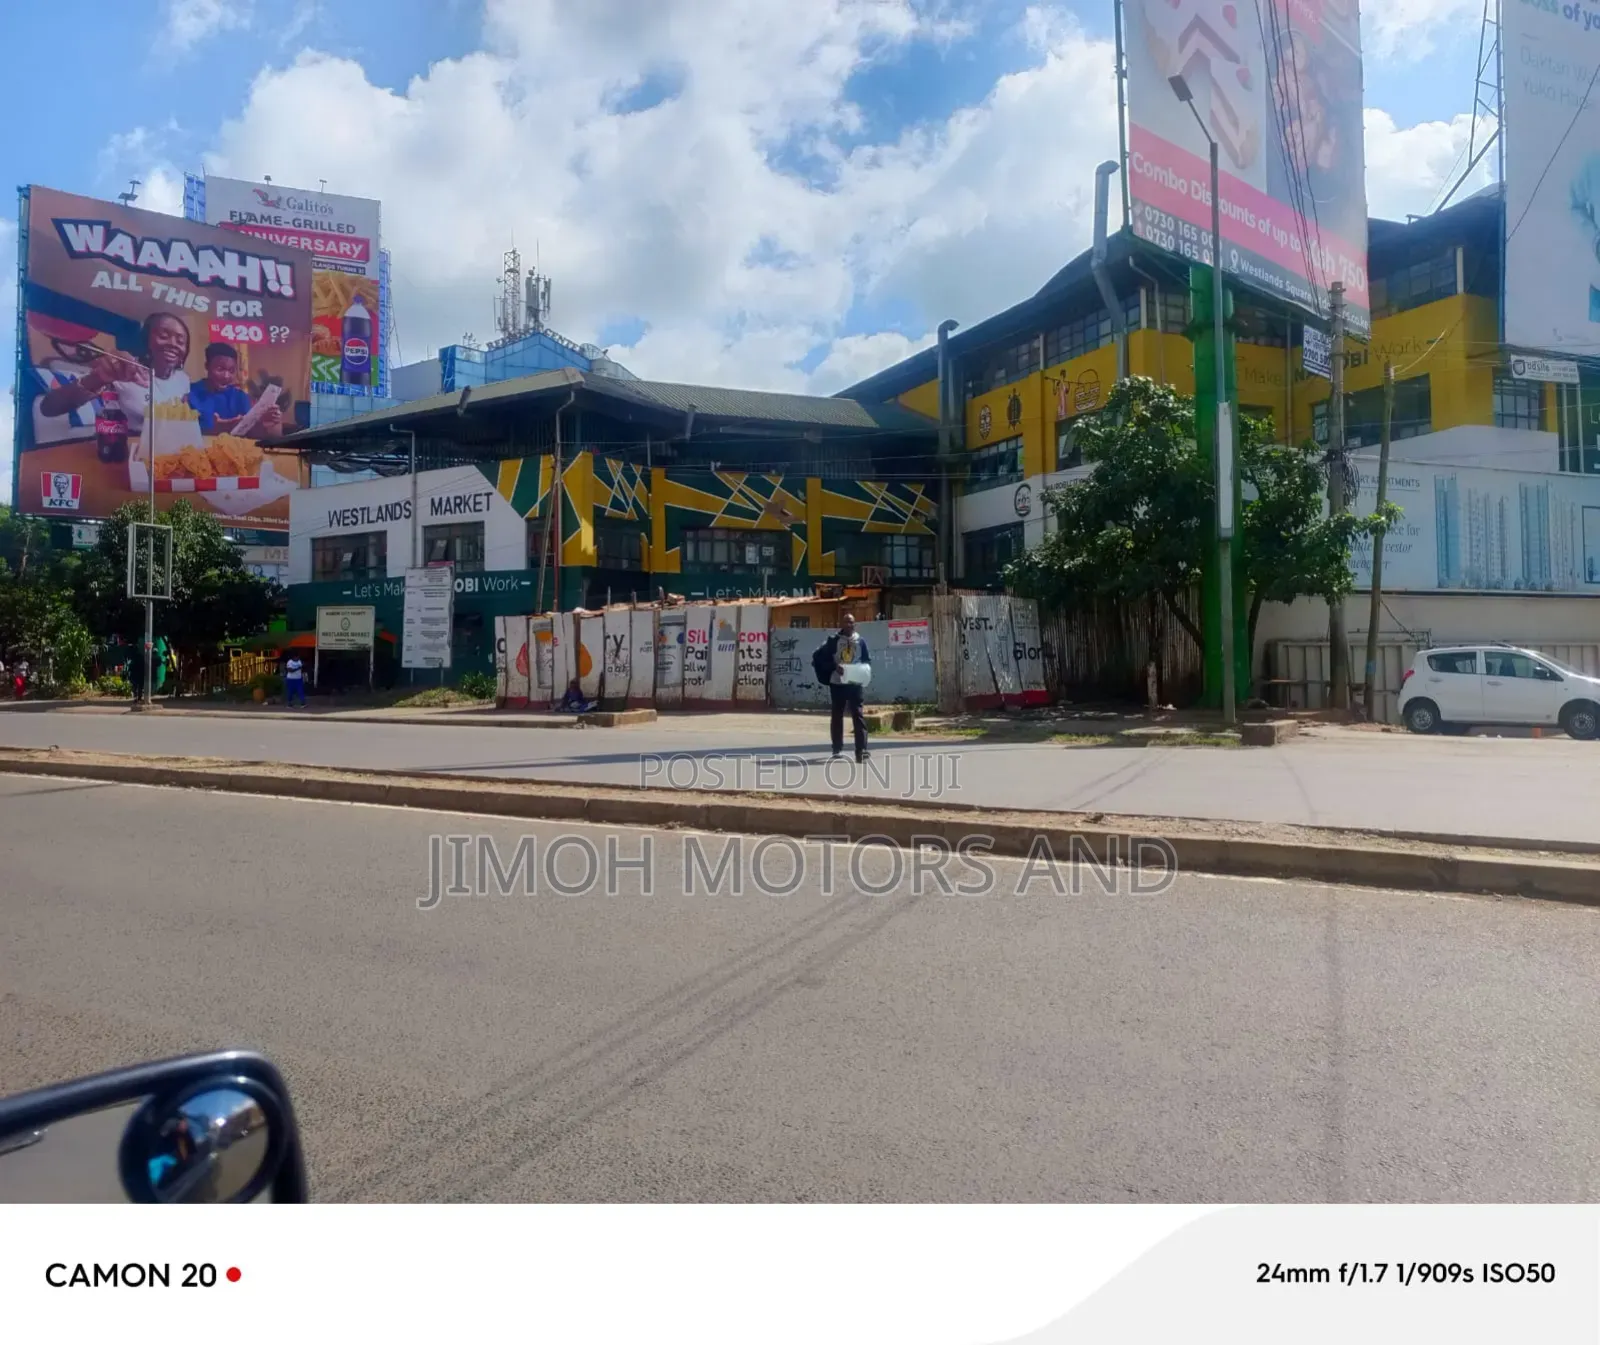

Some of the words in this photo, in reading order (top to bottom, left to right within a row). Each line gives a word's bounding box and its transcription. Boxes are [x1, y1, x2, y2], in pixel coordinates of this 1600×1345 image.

[1562, 2, 1580, 22] of
[286, 196, 334, 215] Galito's
[229, 210, 356, 235] FLAME-GRILLED
[1132, 152, 1188, 196] Combo
[1190, 178, 1257, 229] Disounts
[1258, 217, 1273, 237] of
[1272, 224, 1288, 249] up
[1289, 233, 1302, 253] to
[1338, 254, 1366, 292] 750
[1144, 205, 1175, 232] 0730
[1178, 220, 1198, 241] 165
[1145, 224, 1175, 252] 0730
[1178, 239, 1200, 261] 165
[59, 220, 294, 299] WAAAAH!!
[91, 270, 142, 292] ALL
[1240, 257, 1284, 290] Westlands
[151, 281, 209, 313] THIS
[216, 299, 264, 317] FOR
[220, 323, 264, 342] 420
[268, 324, 290, 343] ??
[345, 347, 368, 355] PEPSI
[48, 498, 74, 508] KFC
[327, 500, 412, 528] WESTLANDS
[430, 492, 493, 517] MARKET
[354, 583, 381, 599] Let's
[384, 578, 405, 597] Mak
[453, 577, 479, 594] OBI
[482, 572, 519, 590] Work
